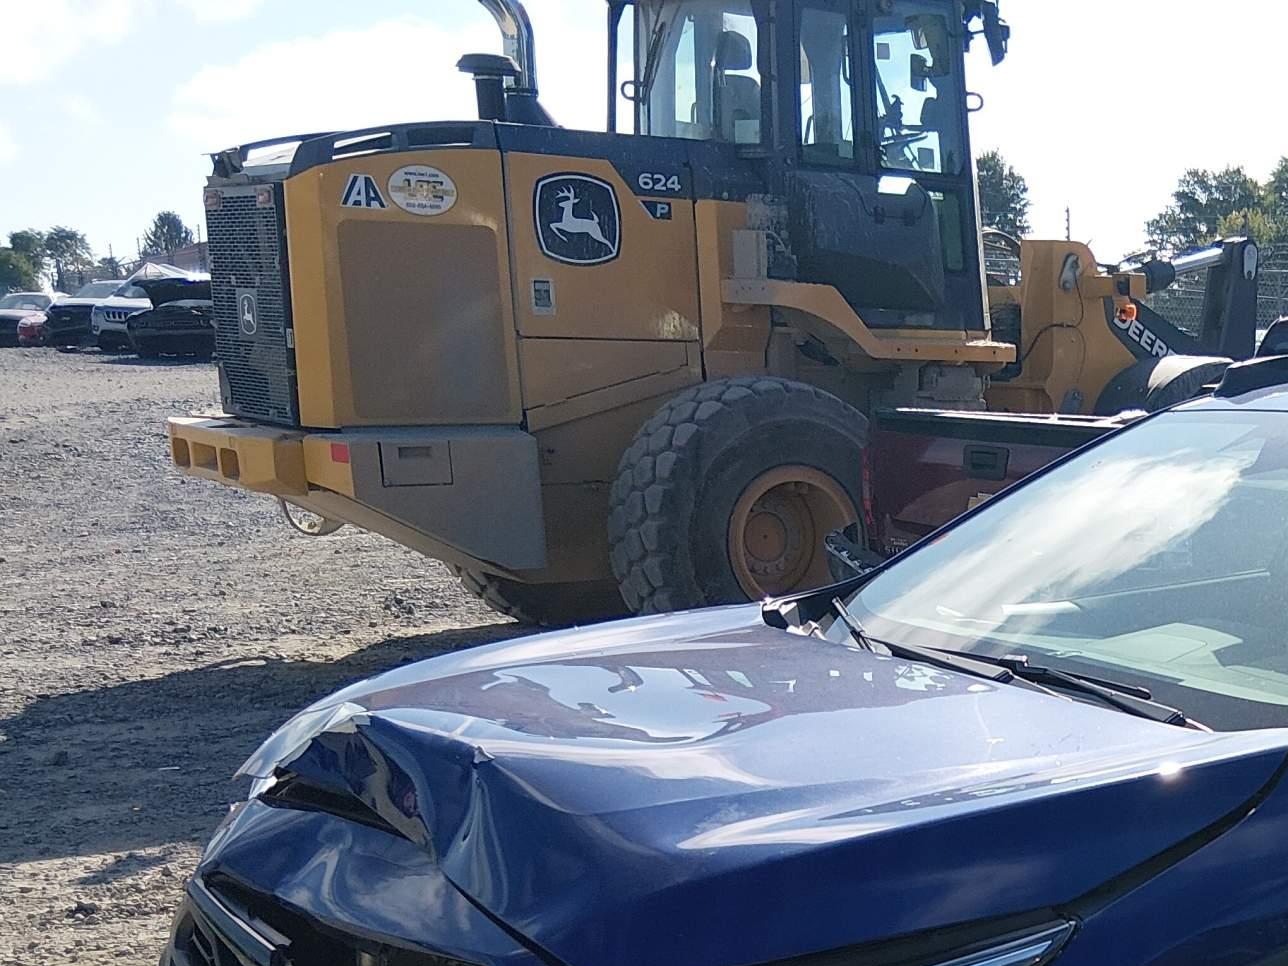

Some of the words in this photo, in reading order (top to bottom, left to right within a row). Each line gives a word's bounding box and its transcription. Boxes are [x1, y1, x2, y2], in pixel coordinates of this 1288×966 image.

[638, 173, 681, 191] 624
[656, 204, 669, 217] P
[1113, 316, 1177, 358] DEER
